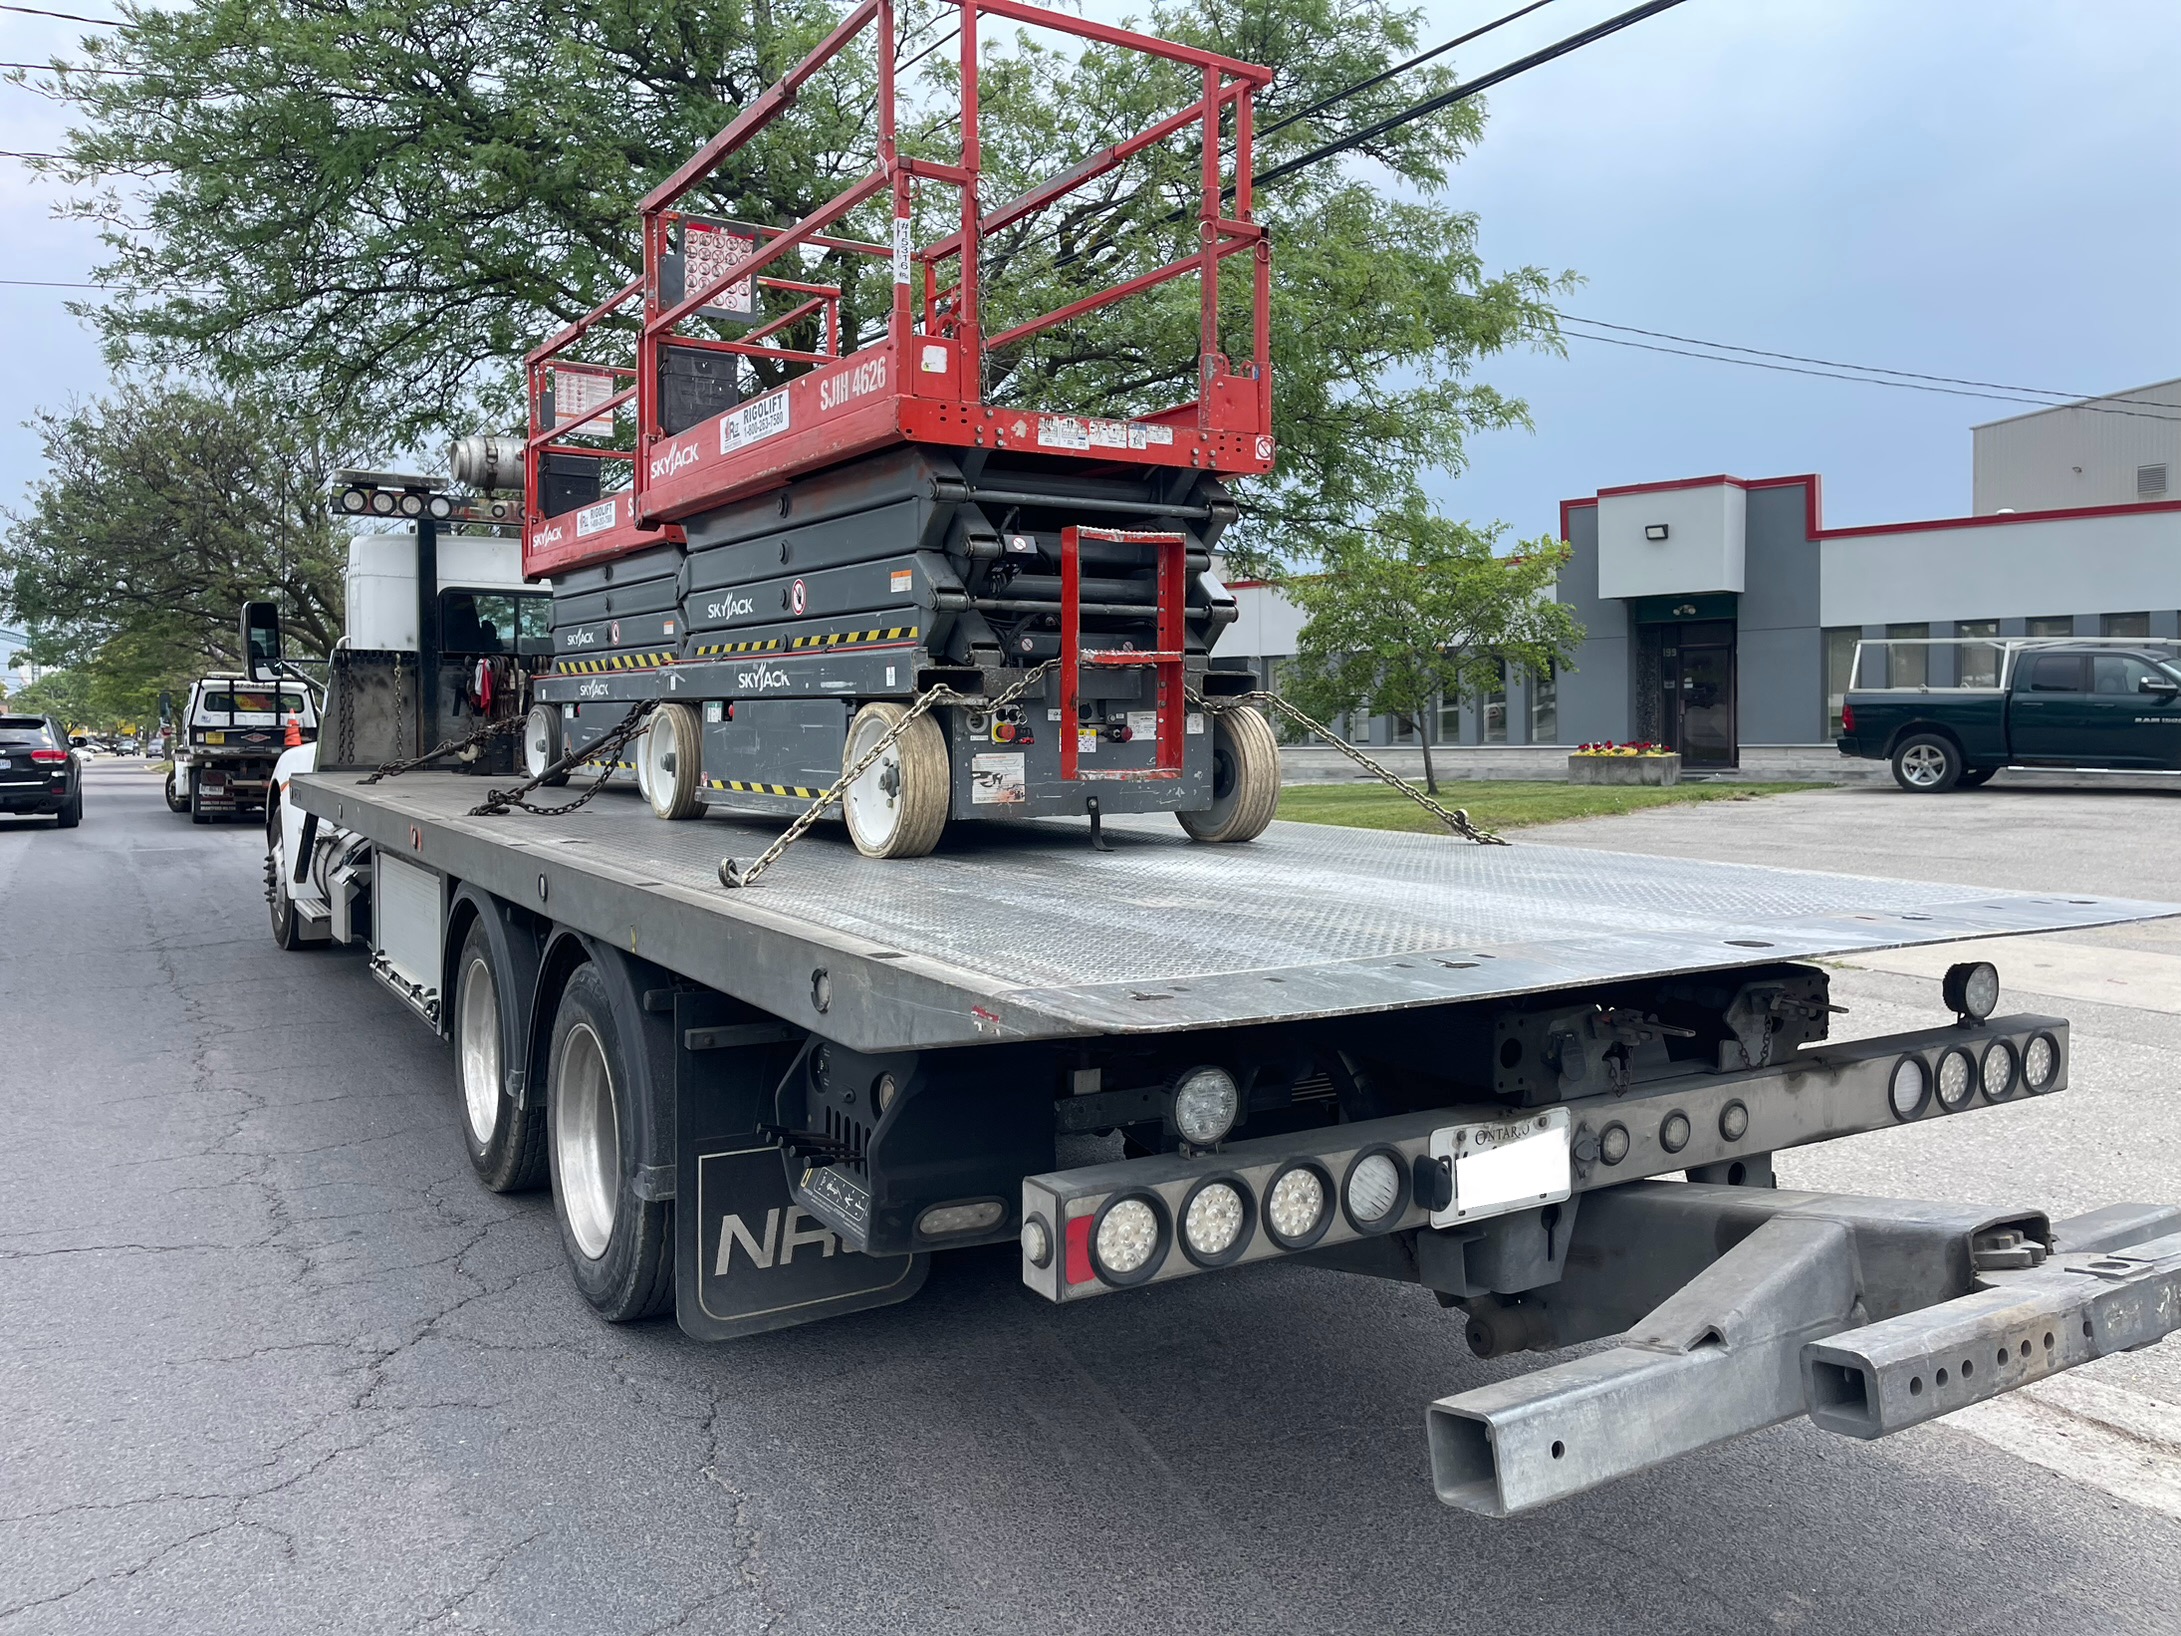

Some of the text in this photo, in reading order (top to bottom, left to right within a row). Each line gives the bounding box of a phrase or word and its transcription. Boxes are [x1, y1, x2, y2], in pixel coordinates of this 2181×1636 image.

[852, 356, 886, 396] 4626
[743, 394, 783, 425] RIGOLIFT
[743, 411, 784, 438] 1-800-263-7580
[650, 442, 700, 479] SKYJACK
[532, 523, 562, 548] SKYJACK
[707, 591, 754, 620] SKYJACK
[567, 627, 595, 647] SKYJACK
[580, 679, 609, 698] SKYJACK
[738, 661, 791, 692] SKYJACK
[715, 1205, 862, 1276] NR
